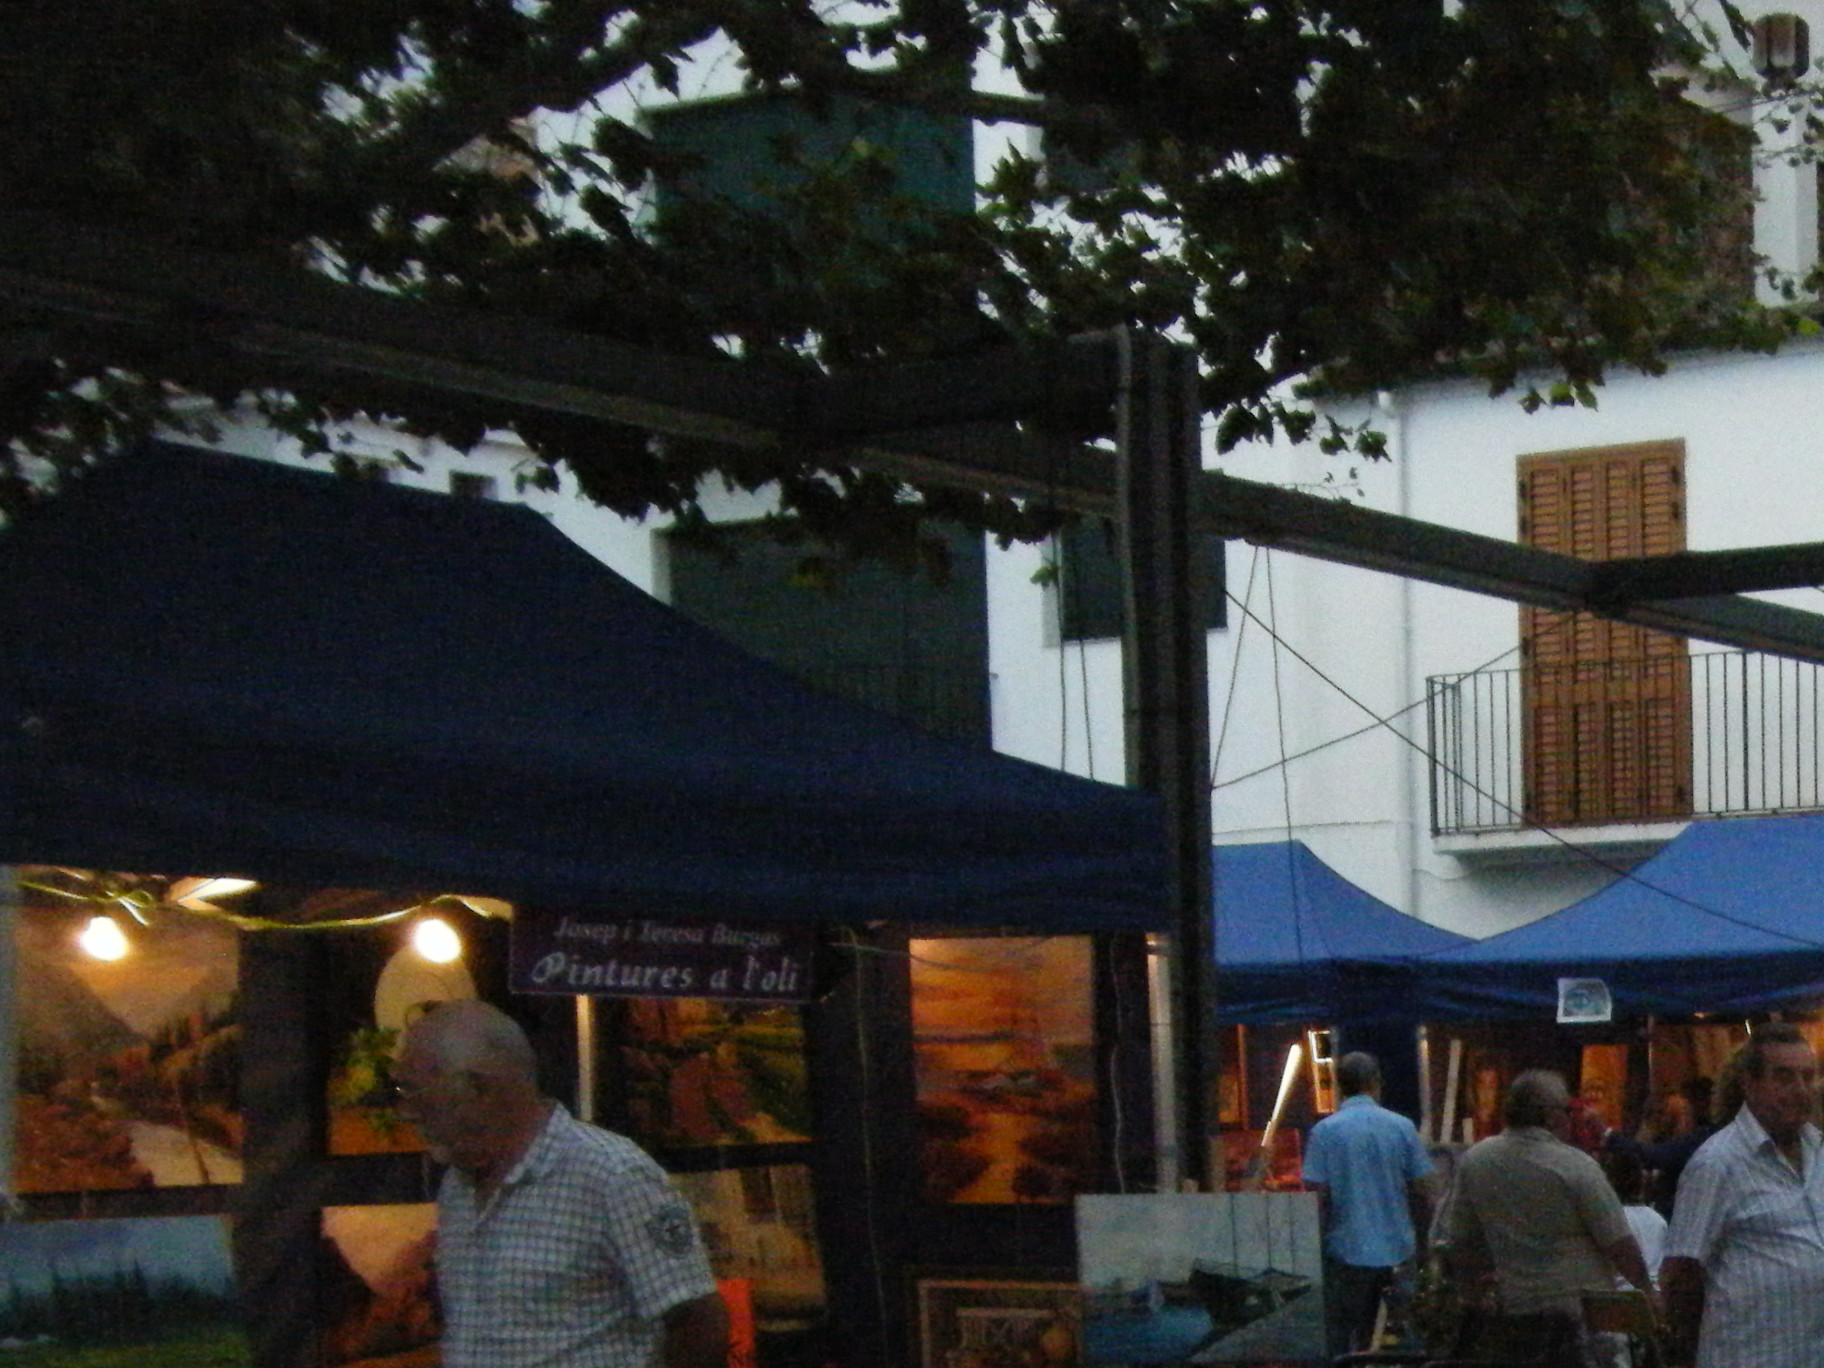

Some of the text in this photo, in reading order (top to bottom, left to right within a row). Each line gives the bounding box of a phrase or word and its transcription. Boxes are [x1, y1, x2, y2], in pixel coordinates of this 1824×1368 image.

[553, 916, 617, 944] Josep
[531, 952, 693, 989] Pintures
[709, 967, 729, 990] a
